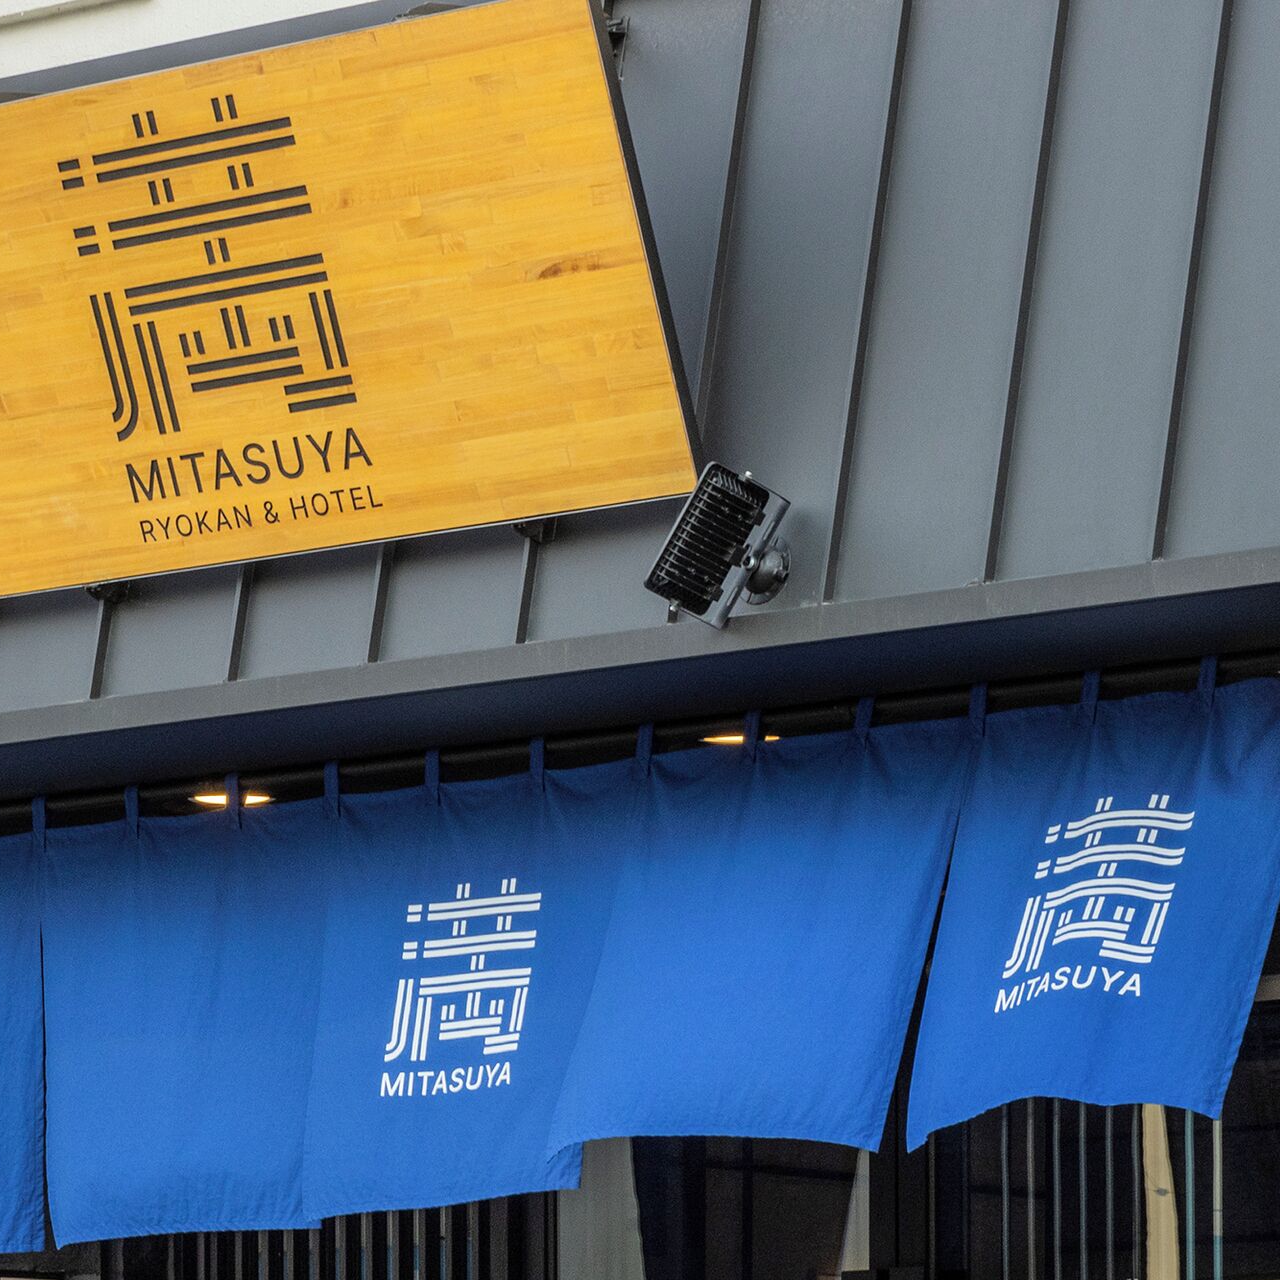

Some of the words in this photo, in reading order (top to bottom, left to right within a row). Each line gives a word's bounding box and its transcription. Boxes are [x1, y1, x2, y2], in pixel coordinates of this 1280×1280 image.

[125, 427, 373, 503] MITASUYA
[139, 504, 253, 543] RYOKAN
[263, 500, 280, 524] &
[289, 485, 383, 520] HOTEL
[994, 965, 1141, 1014] MITASUYA
[380, 1061, 511, 1097] MITASUYA
